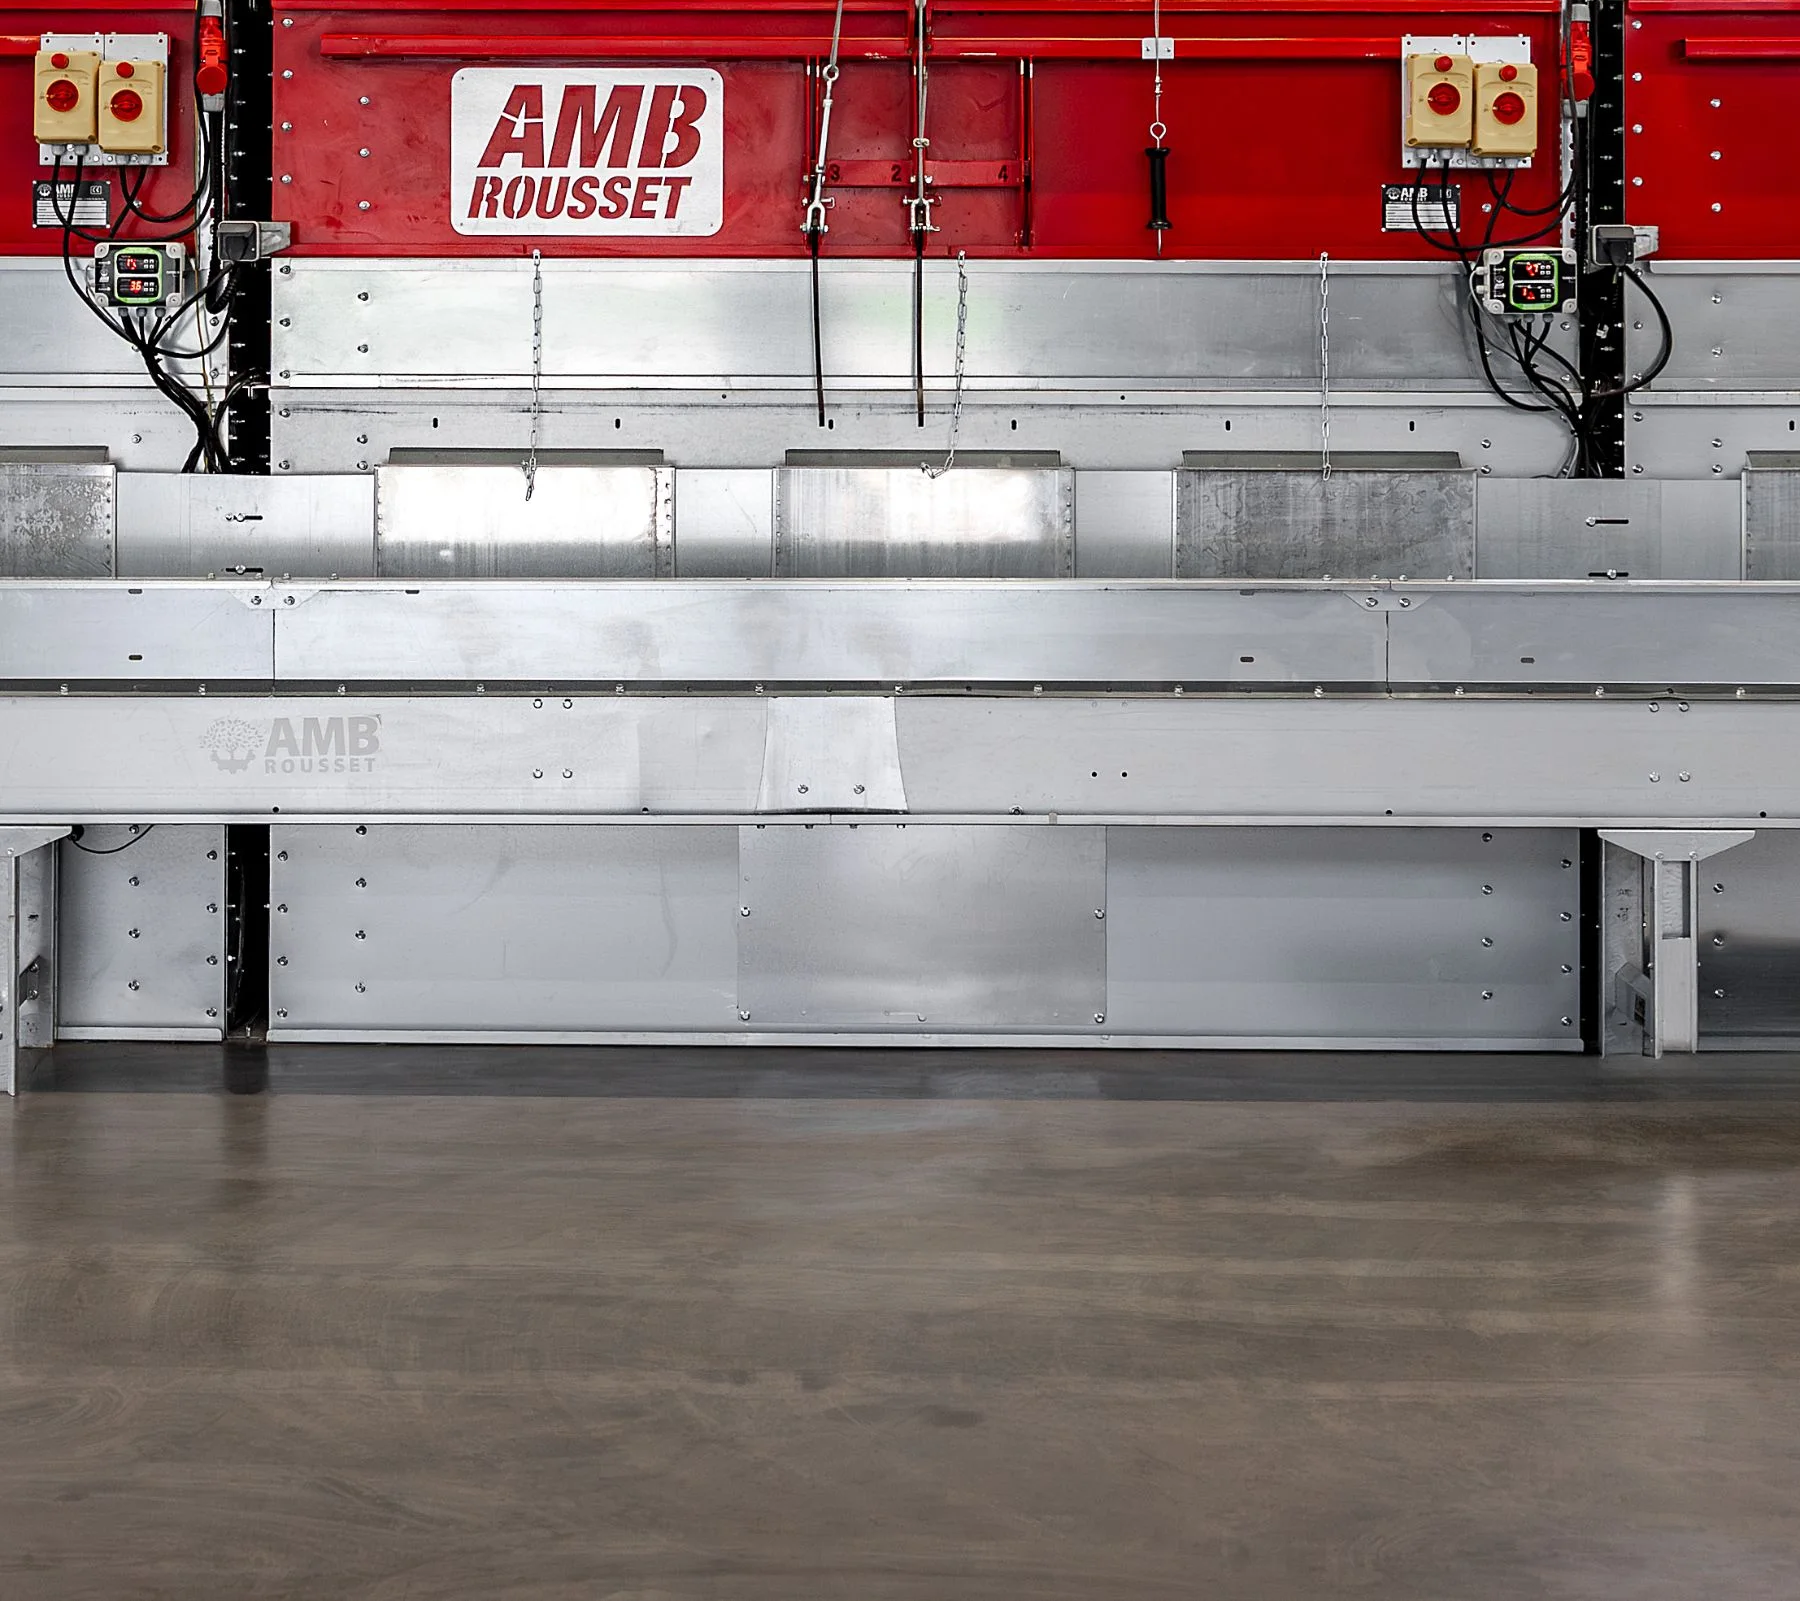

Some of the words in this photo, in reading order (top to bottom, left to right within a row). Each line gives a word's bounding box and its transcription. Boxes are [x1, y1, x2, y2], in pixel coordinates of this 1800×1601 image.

[477, 84, 707, 168] AMB
[829, 163, 841, 182] 3
[891, 164, 902, 182] 2
[998, 165, 1009, 182] 4
[467, 175, 692, 219] ROUSSET
[264, 717, 380, 757] AMB
[264, 758, 376, 773] ROUSSET
